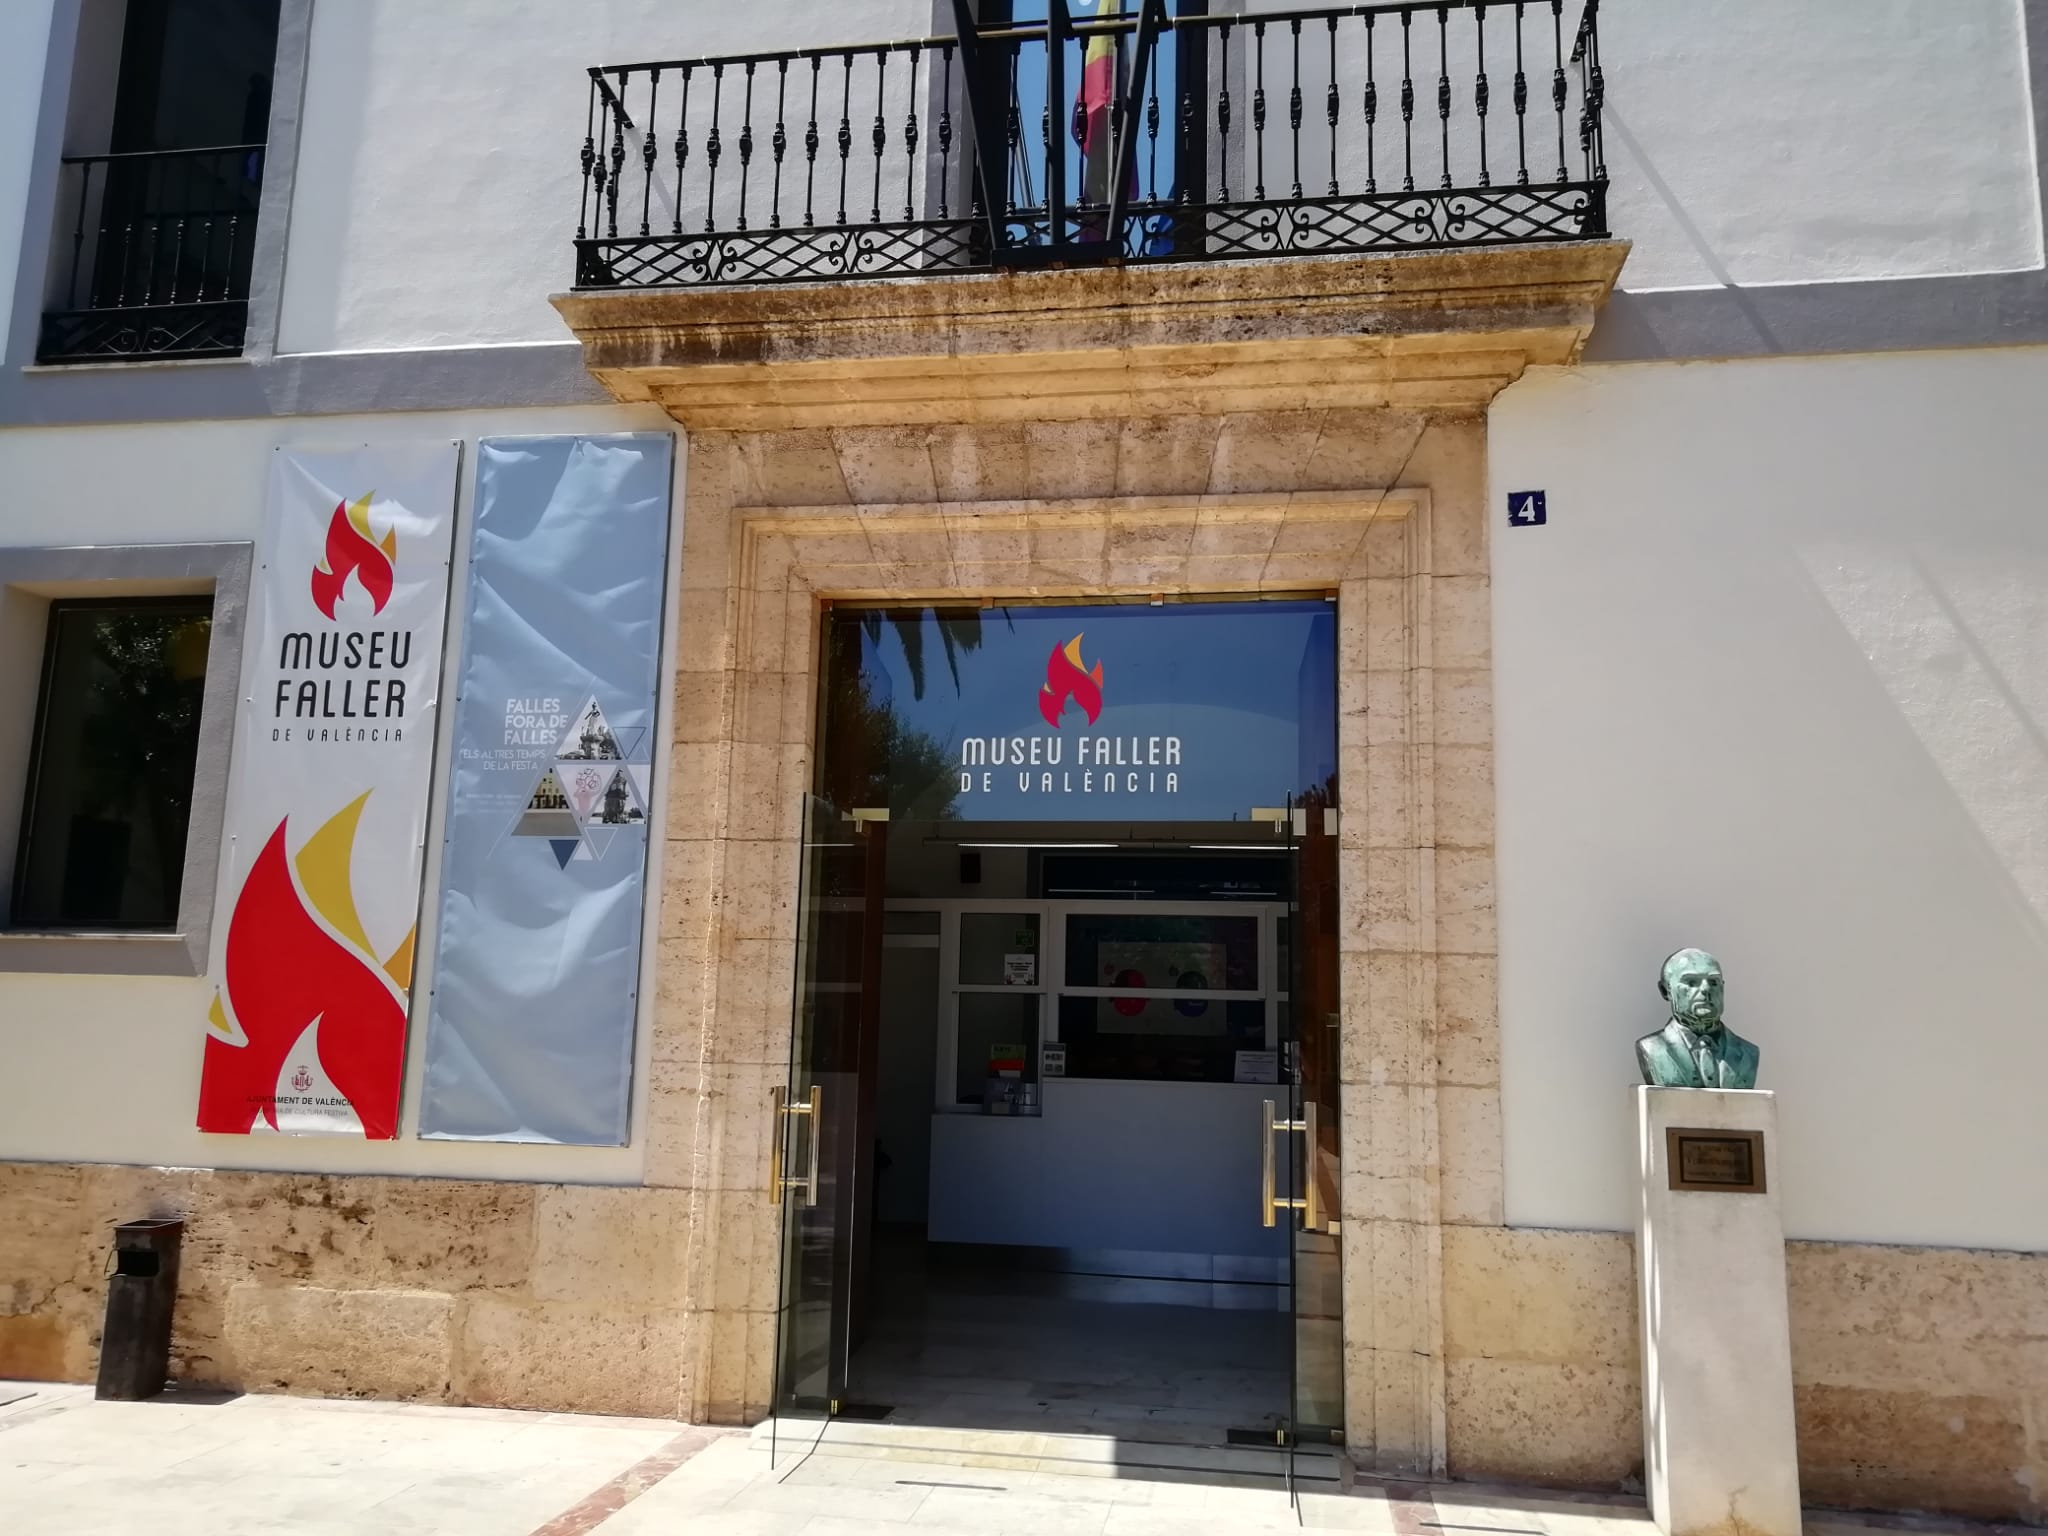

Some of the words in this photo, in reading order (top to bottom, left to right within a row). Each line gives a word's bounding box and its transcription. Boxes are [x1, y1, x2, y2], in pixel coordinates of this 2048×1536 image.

[1518, 495, 1536, 522] 4
[280, 631, 411, 669] MUSEU
[275, 680, 406, 718] FALLER
[506, 698, 560, 714] FALLES
[505, 715, 546, 729] FORA
[549, 715, 569, 728] DE
[272, 728, 291, 742] DE
[307, 726, 403, 742] VALÈNCIA
[504, 730, 558, 745] FALLES
[481, 748, 515, 760] ALTRES
[517, 749, 546, 759] TEMPS
[962, 737, 1062, 766] MUSEU
[1078, 736, 1181, 765] FALLER
[483, 761, 498, 771] DE
[499, 761, 509, 771] LA
[511, 760, 538, 771] FESTA
[961, 772, 992, 793] DE
[1019, 768, 1178, 793] VALÈNCIA
[301, 1097, 313, 1105] DE
